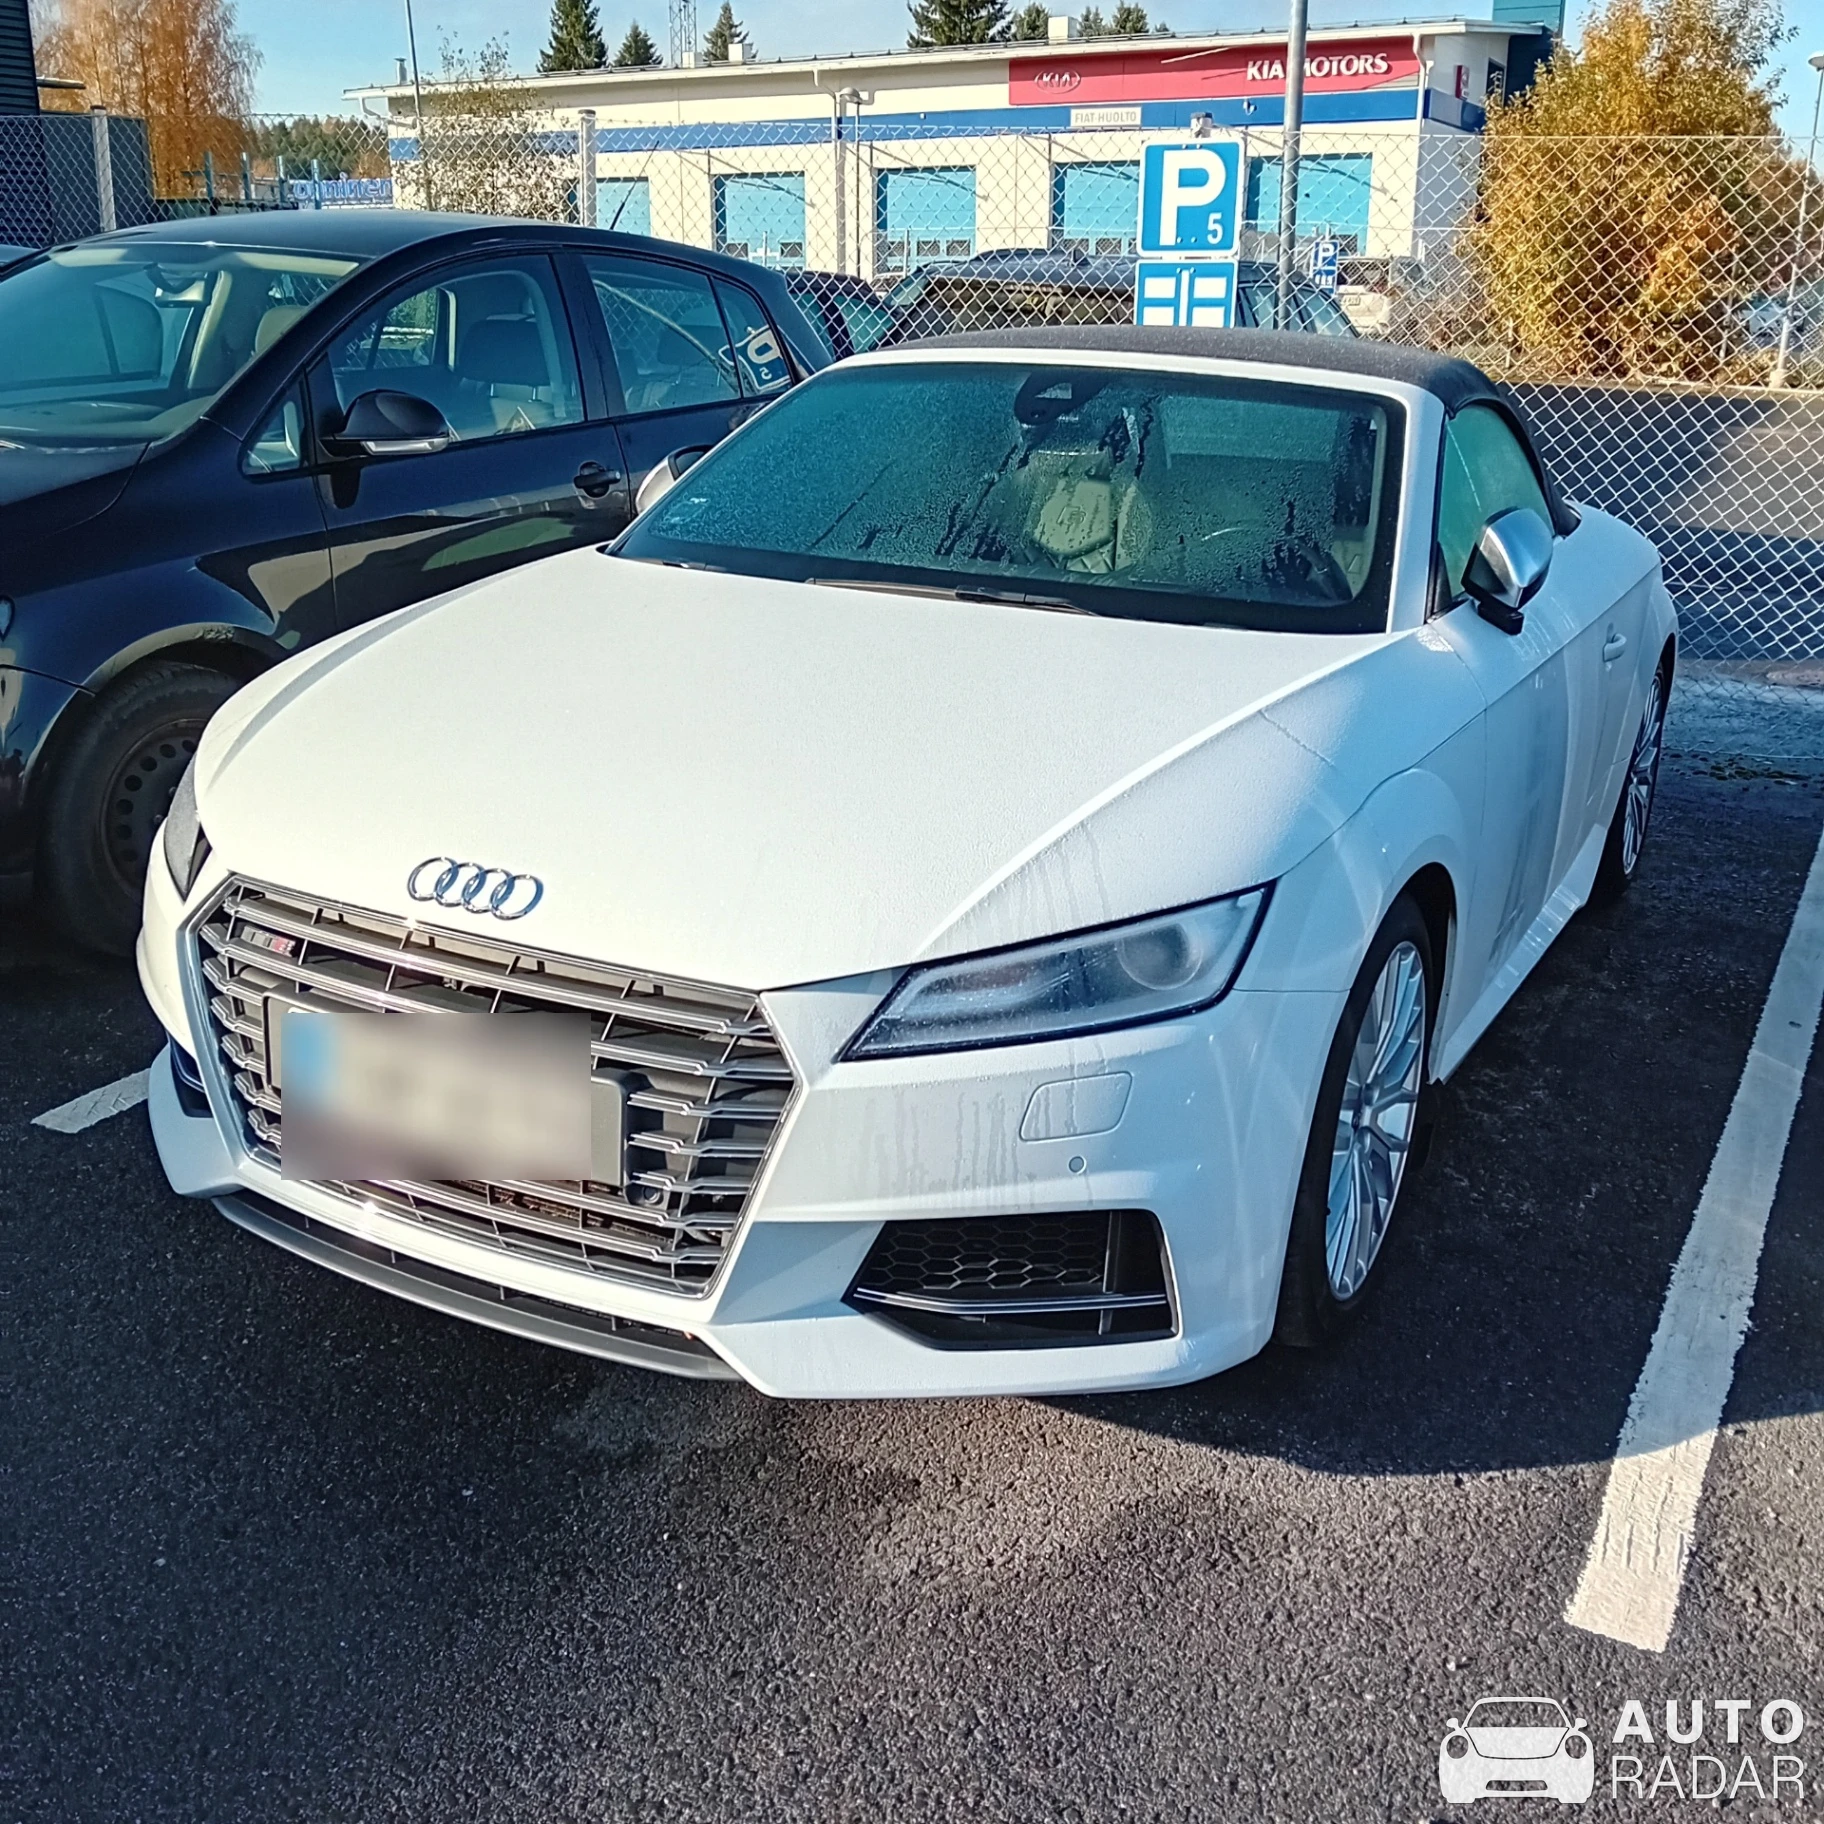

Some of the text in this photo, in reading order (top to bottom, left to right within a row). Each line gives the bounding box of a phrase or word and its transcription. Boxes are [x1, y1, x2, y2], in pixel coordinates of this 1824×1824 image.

[1042, 71, 1072, 88] KIA
[1247, 59, 1285, 80] KIA
[1159, 149, 1226, 246] P
[1207, 212, 1223, 245] 5
[1317, 243, 1335, 267] P
